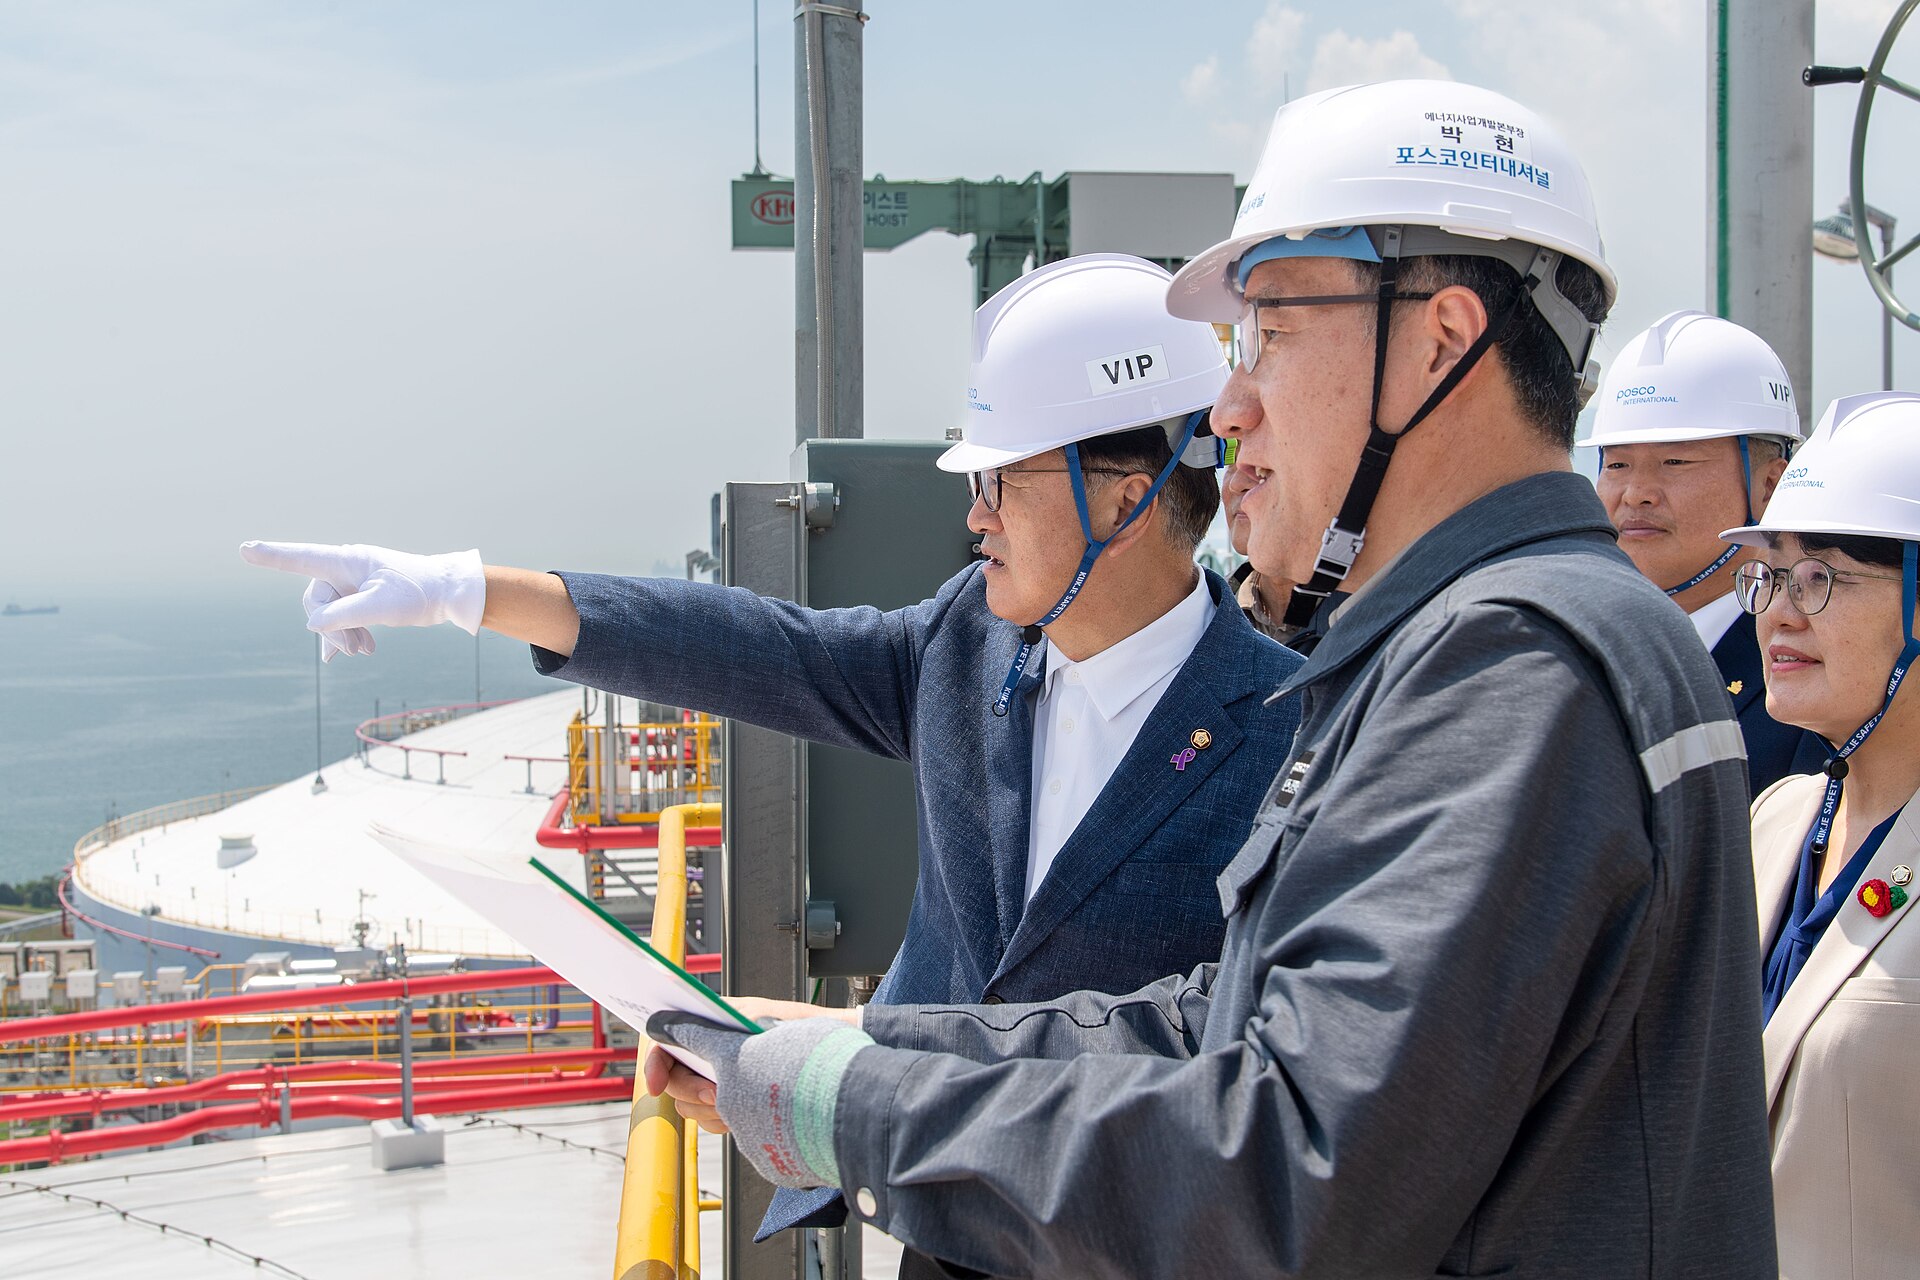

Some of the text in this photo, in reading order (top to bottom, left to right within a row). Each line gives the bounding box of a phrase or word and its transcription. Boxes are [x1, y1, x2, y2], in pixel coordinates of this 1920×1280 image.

[1424, 112, 1524, 139] 에너지사업개발본부장
[1441, 126, 1514, 155] 박 현
[1396, 147, 1550, 190] 포스코인터내셔널
[759, 198, 794, 218] KH
[866, 213, 909, 227] HOIST
[1101, 353, 1154, 385] VIP
[1622, 396, 1679, 405] INTERNATIONAL
[1768, 381, 1790, 402] VIP
[1690, 545, 1738, 585] KUKJE SAFETY
[1050, 571, 1087, 618] KUKJE SAFETY
[1887, 667, 1905, 696] KUKJE
[1838, 738, 1860, 758] KUKJE
[1815, 817, 1830, 845] KUKJE
